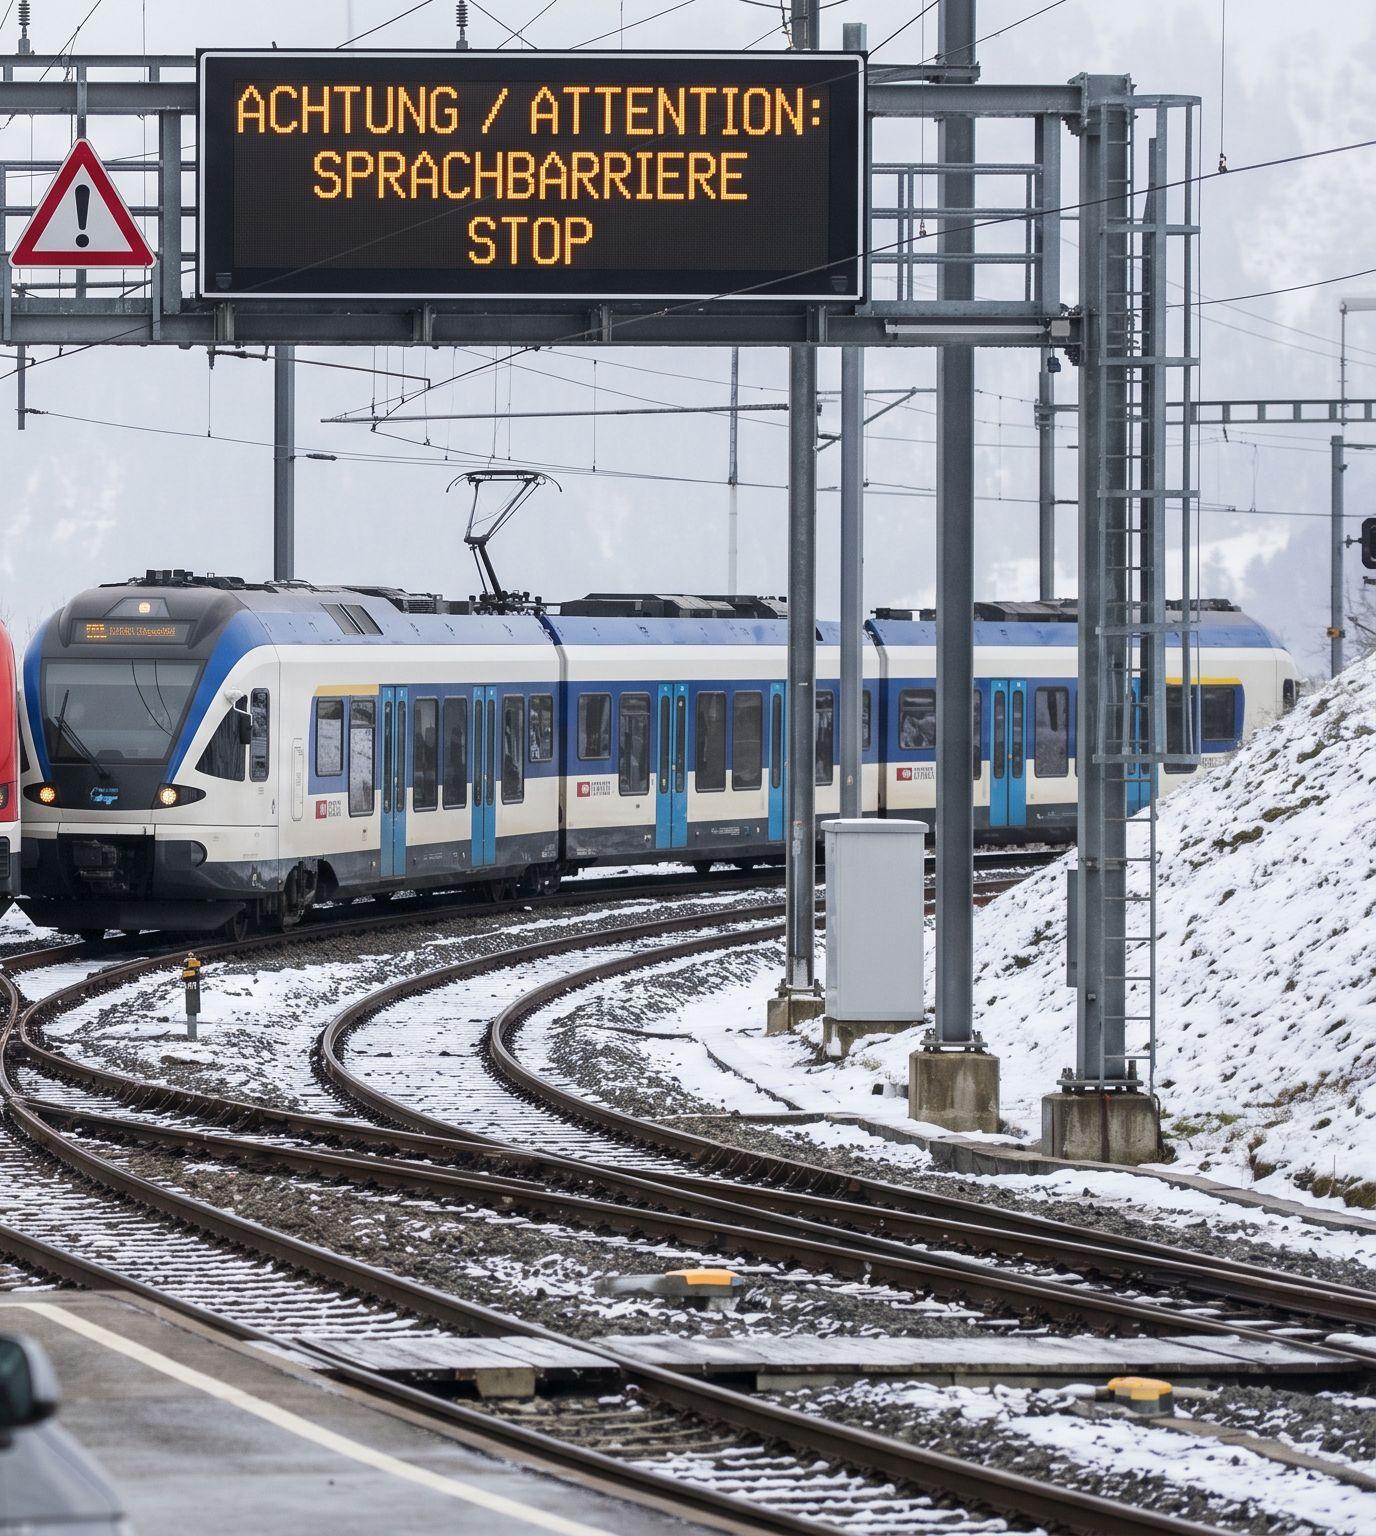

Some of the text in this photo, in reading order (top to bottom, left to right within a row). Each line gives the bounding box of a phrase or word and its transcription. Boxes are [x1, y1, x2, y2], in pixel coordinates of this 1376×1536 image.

[237, 85, 821, 136] ACHTUNG / ATTENTION:
[313, 150, 748, 200] SPRACHBARRIERE
[468, 216, 593, 265] STOP
